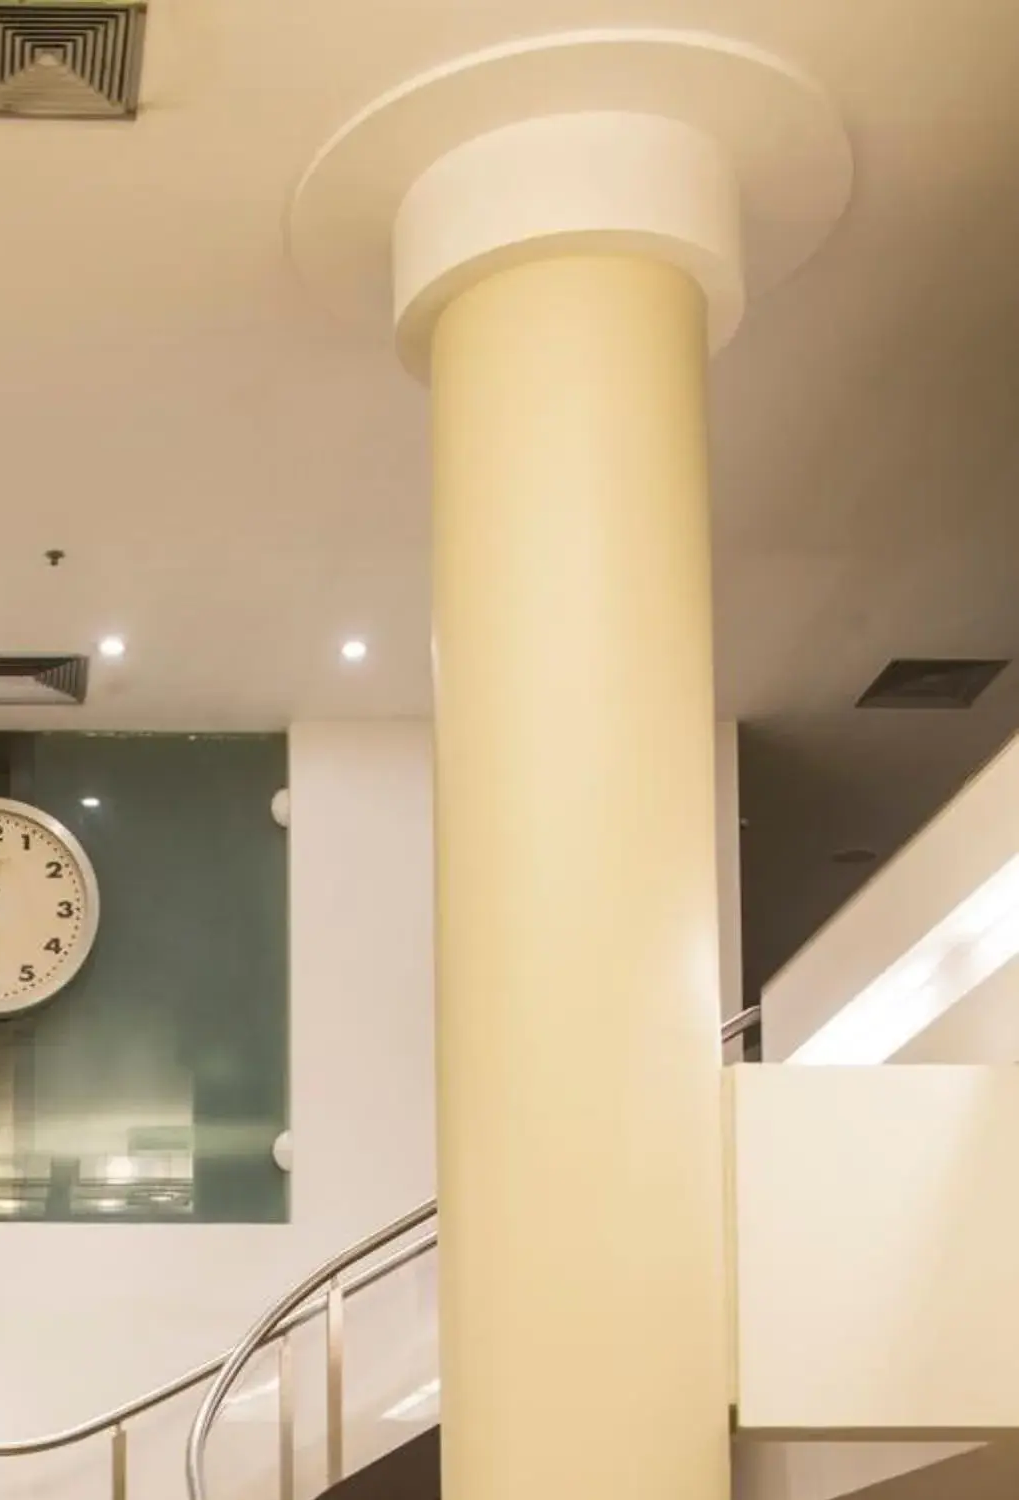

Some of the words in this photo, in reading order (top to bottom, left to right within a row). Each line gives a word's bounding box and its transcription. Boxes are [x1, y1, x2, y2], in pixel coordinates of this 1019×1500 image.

[21, 834, 30, 850] 1
[45, 861, 63, 879] 2
[56, 901, 73, 918] 3
[43, 937, 63, 954] 4
[19, 965, 35, 982] 5
